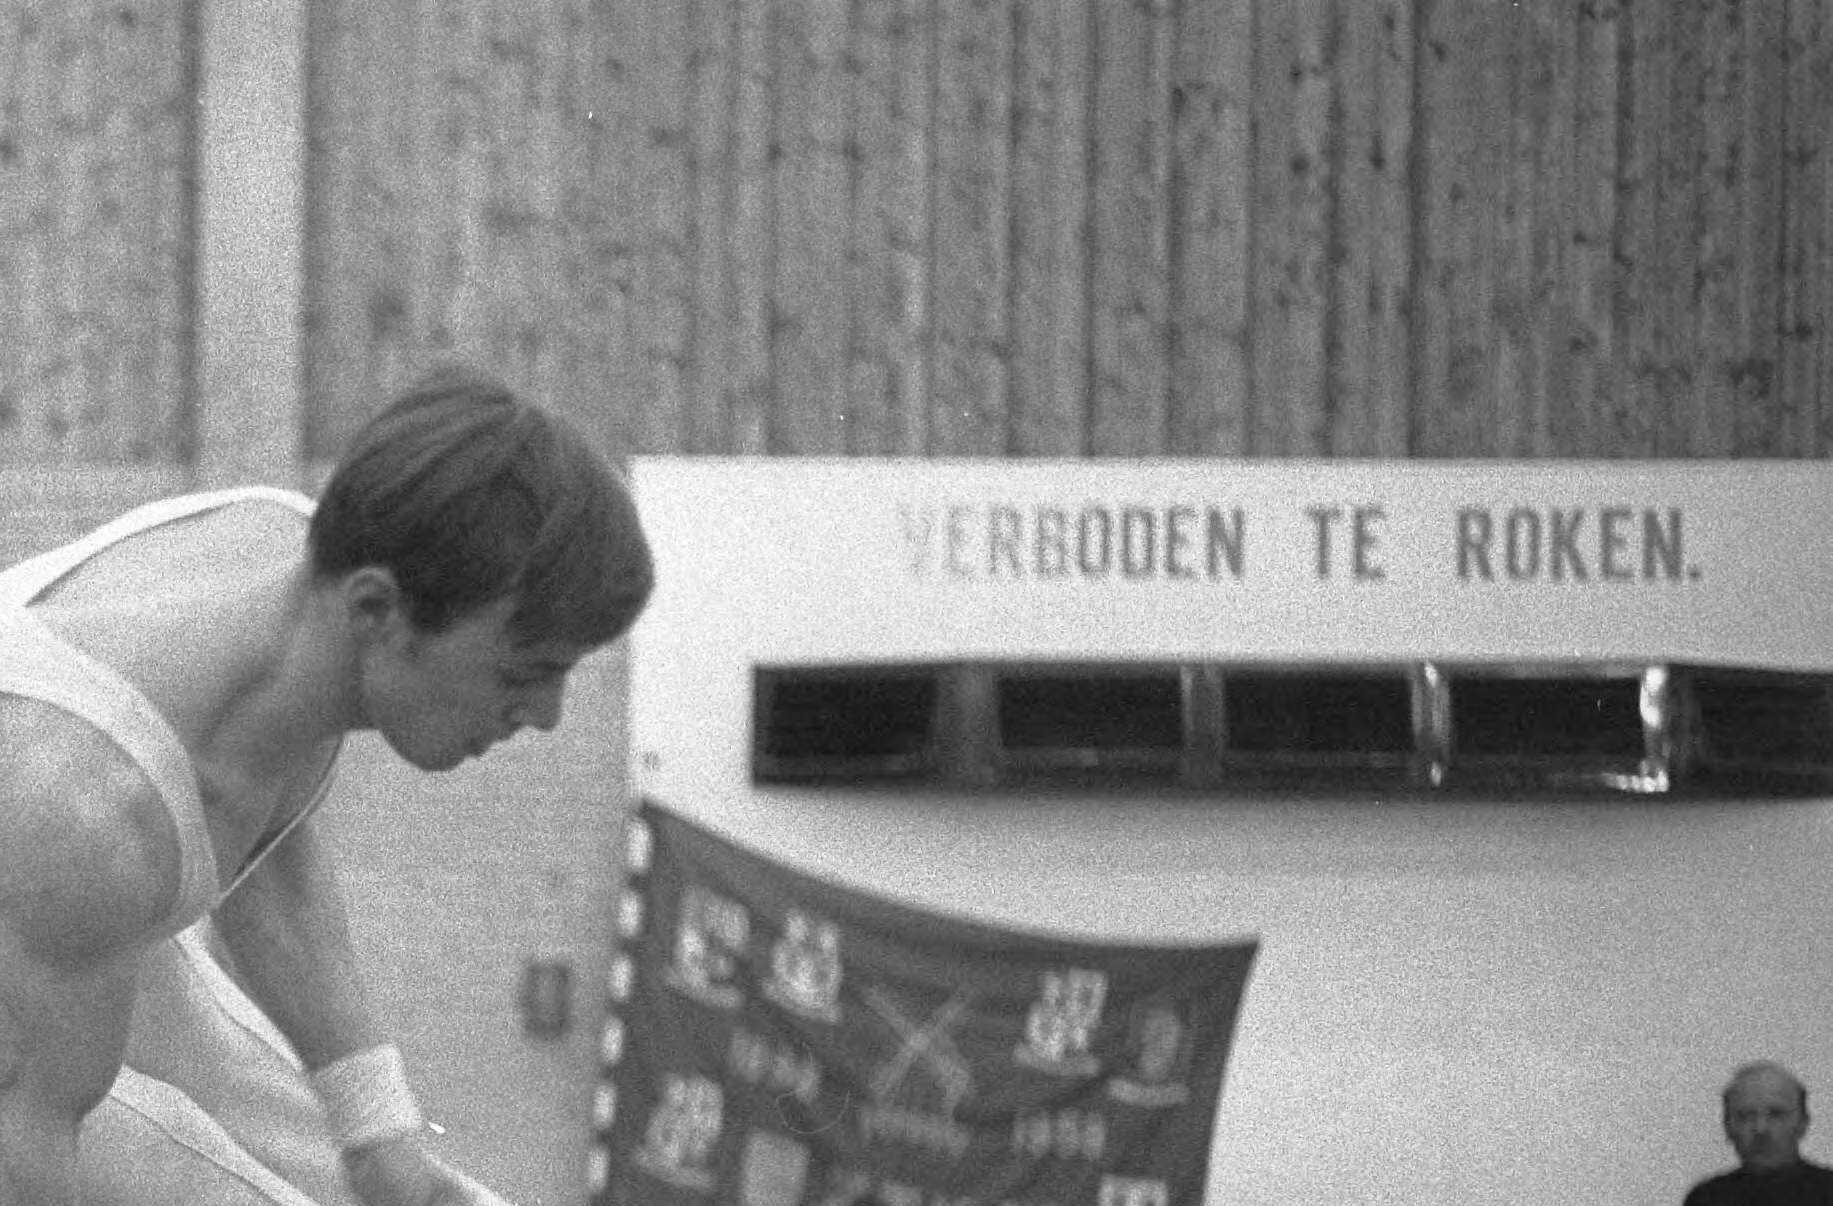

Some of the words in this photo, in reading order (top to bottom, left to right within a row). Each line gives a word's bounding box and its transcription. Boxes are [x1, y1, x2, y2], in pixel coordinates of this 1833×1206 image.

[902, 504, 1245, 579] VERBODEN
[1306, 505, 1385, 580] TE
[1457, 507, 1701, 581] ROKEN.
